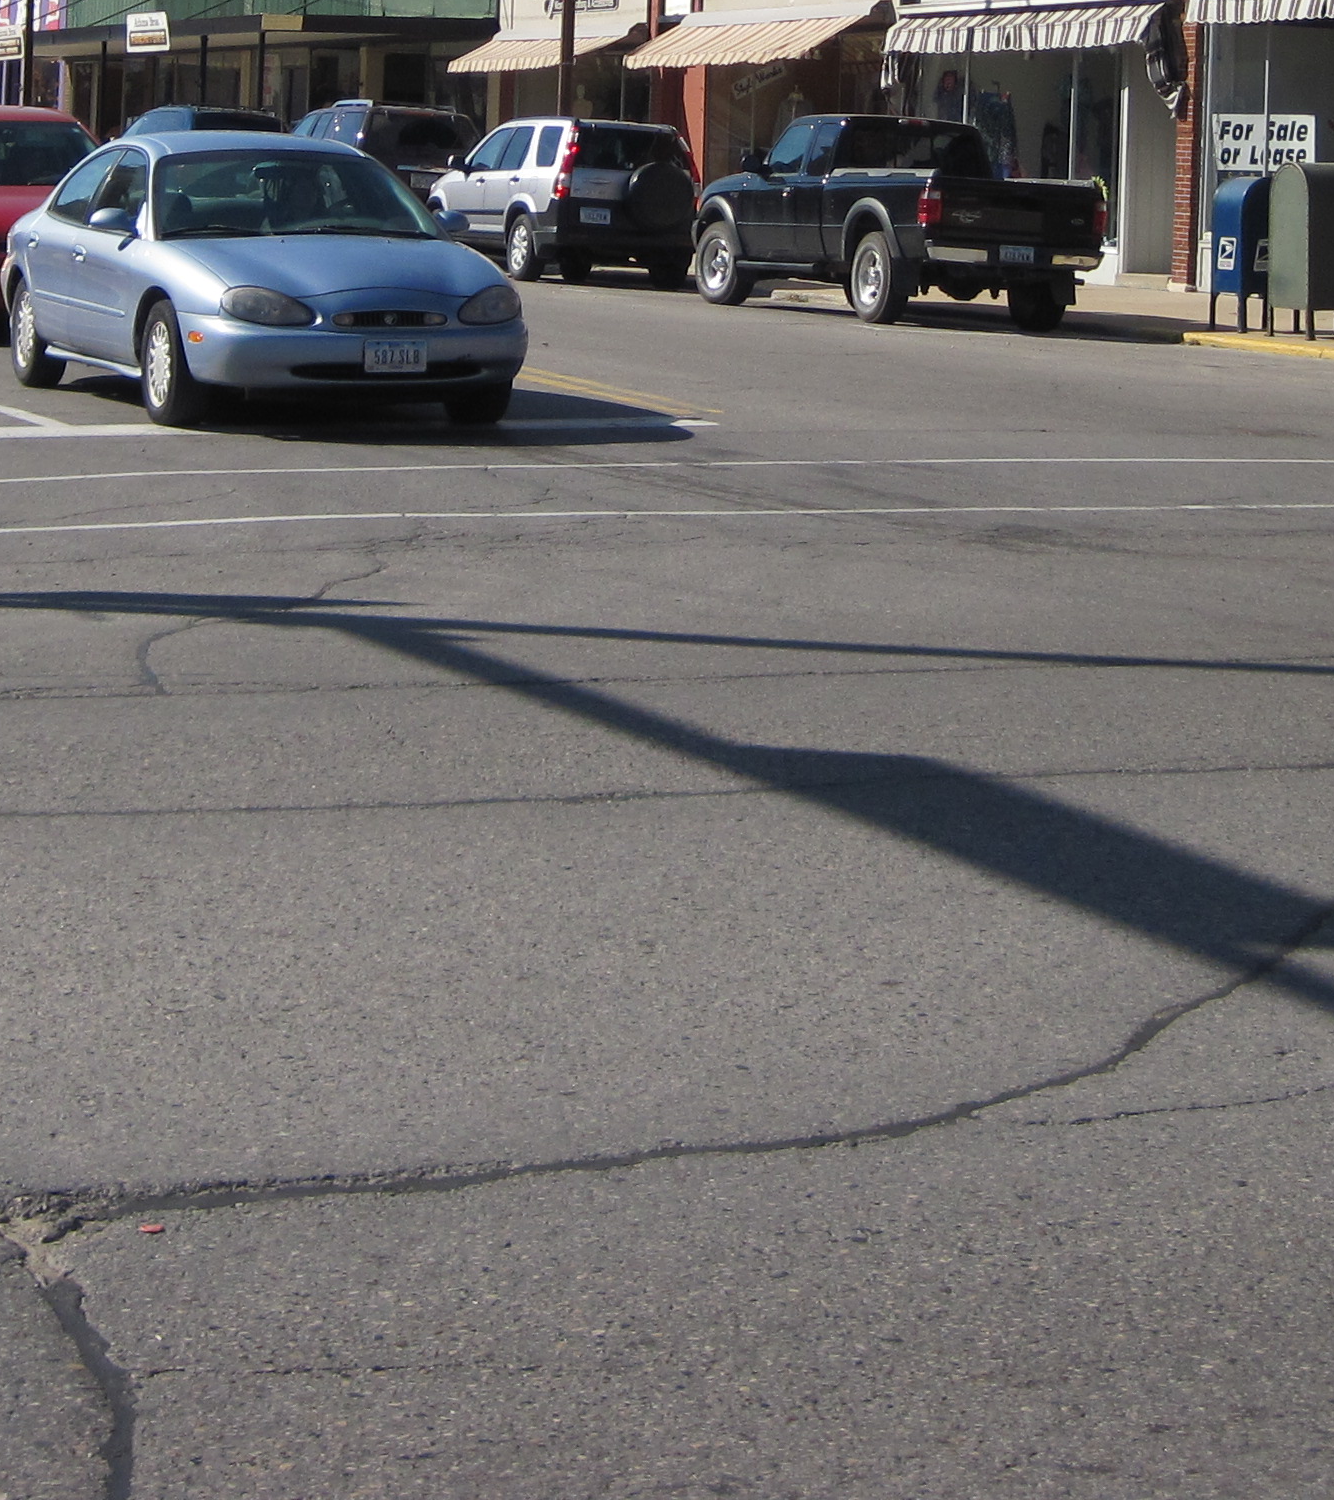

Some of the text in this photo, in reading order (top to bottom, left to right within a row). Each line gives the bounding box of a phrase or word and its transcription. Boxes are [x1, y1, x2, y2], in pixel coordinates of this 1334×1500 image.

[1219, 120, 1308, 142] For Sale
[1221, 145, 1307, 166] or Lease
